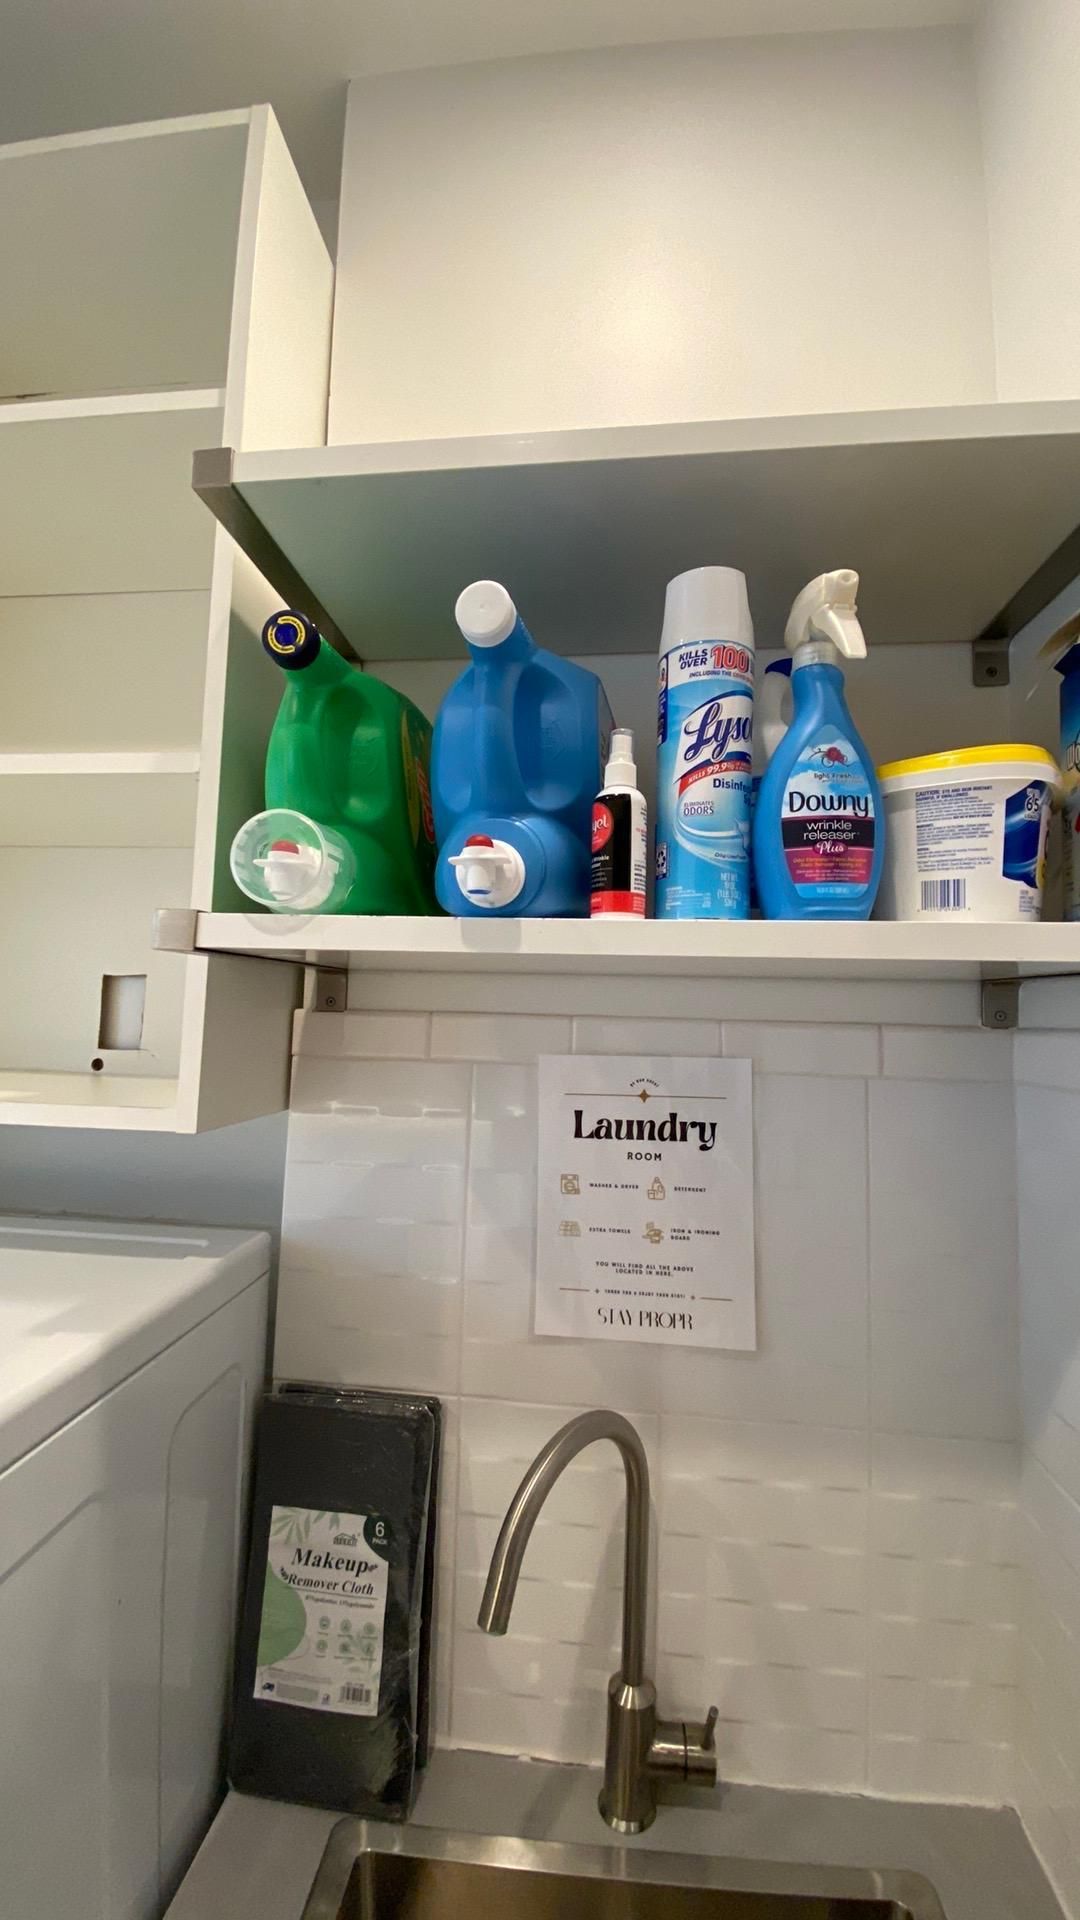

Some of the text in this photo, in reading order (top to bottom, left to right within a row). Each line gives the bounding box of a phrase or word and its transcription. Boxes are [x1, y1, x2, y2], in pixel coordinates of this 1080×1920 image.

[679, 648, 708, 663] KILLS
[680, 644, 750, 673] OVER 100
[689, 669, 721, 678] INCLUDING
[684, 702, 753, 761] Lyso
[683, 806, 714, 816] ODORS
[789, 791, 869, 818] Downy
[1026, 797, 1040, 812] 65
[806, 820, 852, 831] wrinkle
[803, 830, 857, 841] releaser
[816, 840, 845, 855] Plus
[573, 1109, 717, 1152] Laundry
[626, 1151, 662, 1162] ROOM
[598, 1307, 693, 1331] STAY PROPR
[375, 1521, 385, 1537] 6
[372, 1537, 388, 1545] PACK
[291, 1548, 369, 1578] Makeup
[288, 1573, 374, 1596] Remover Cloth
